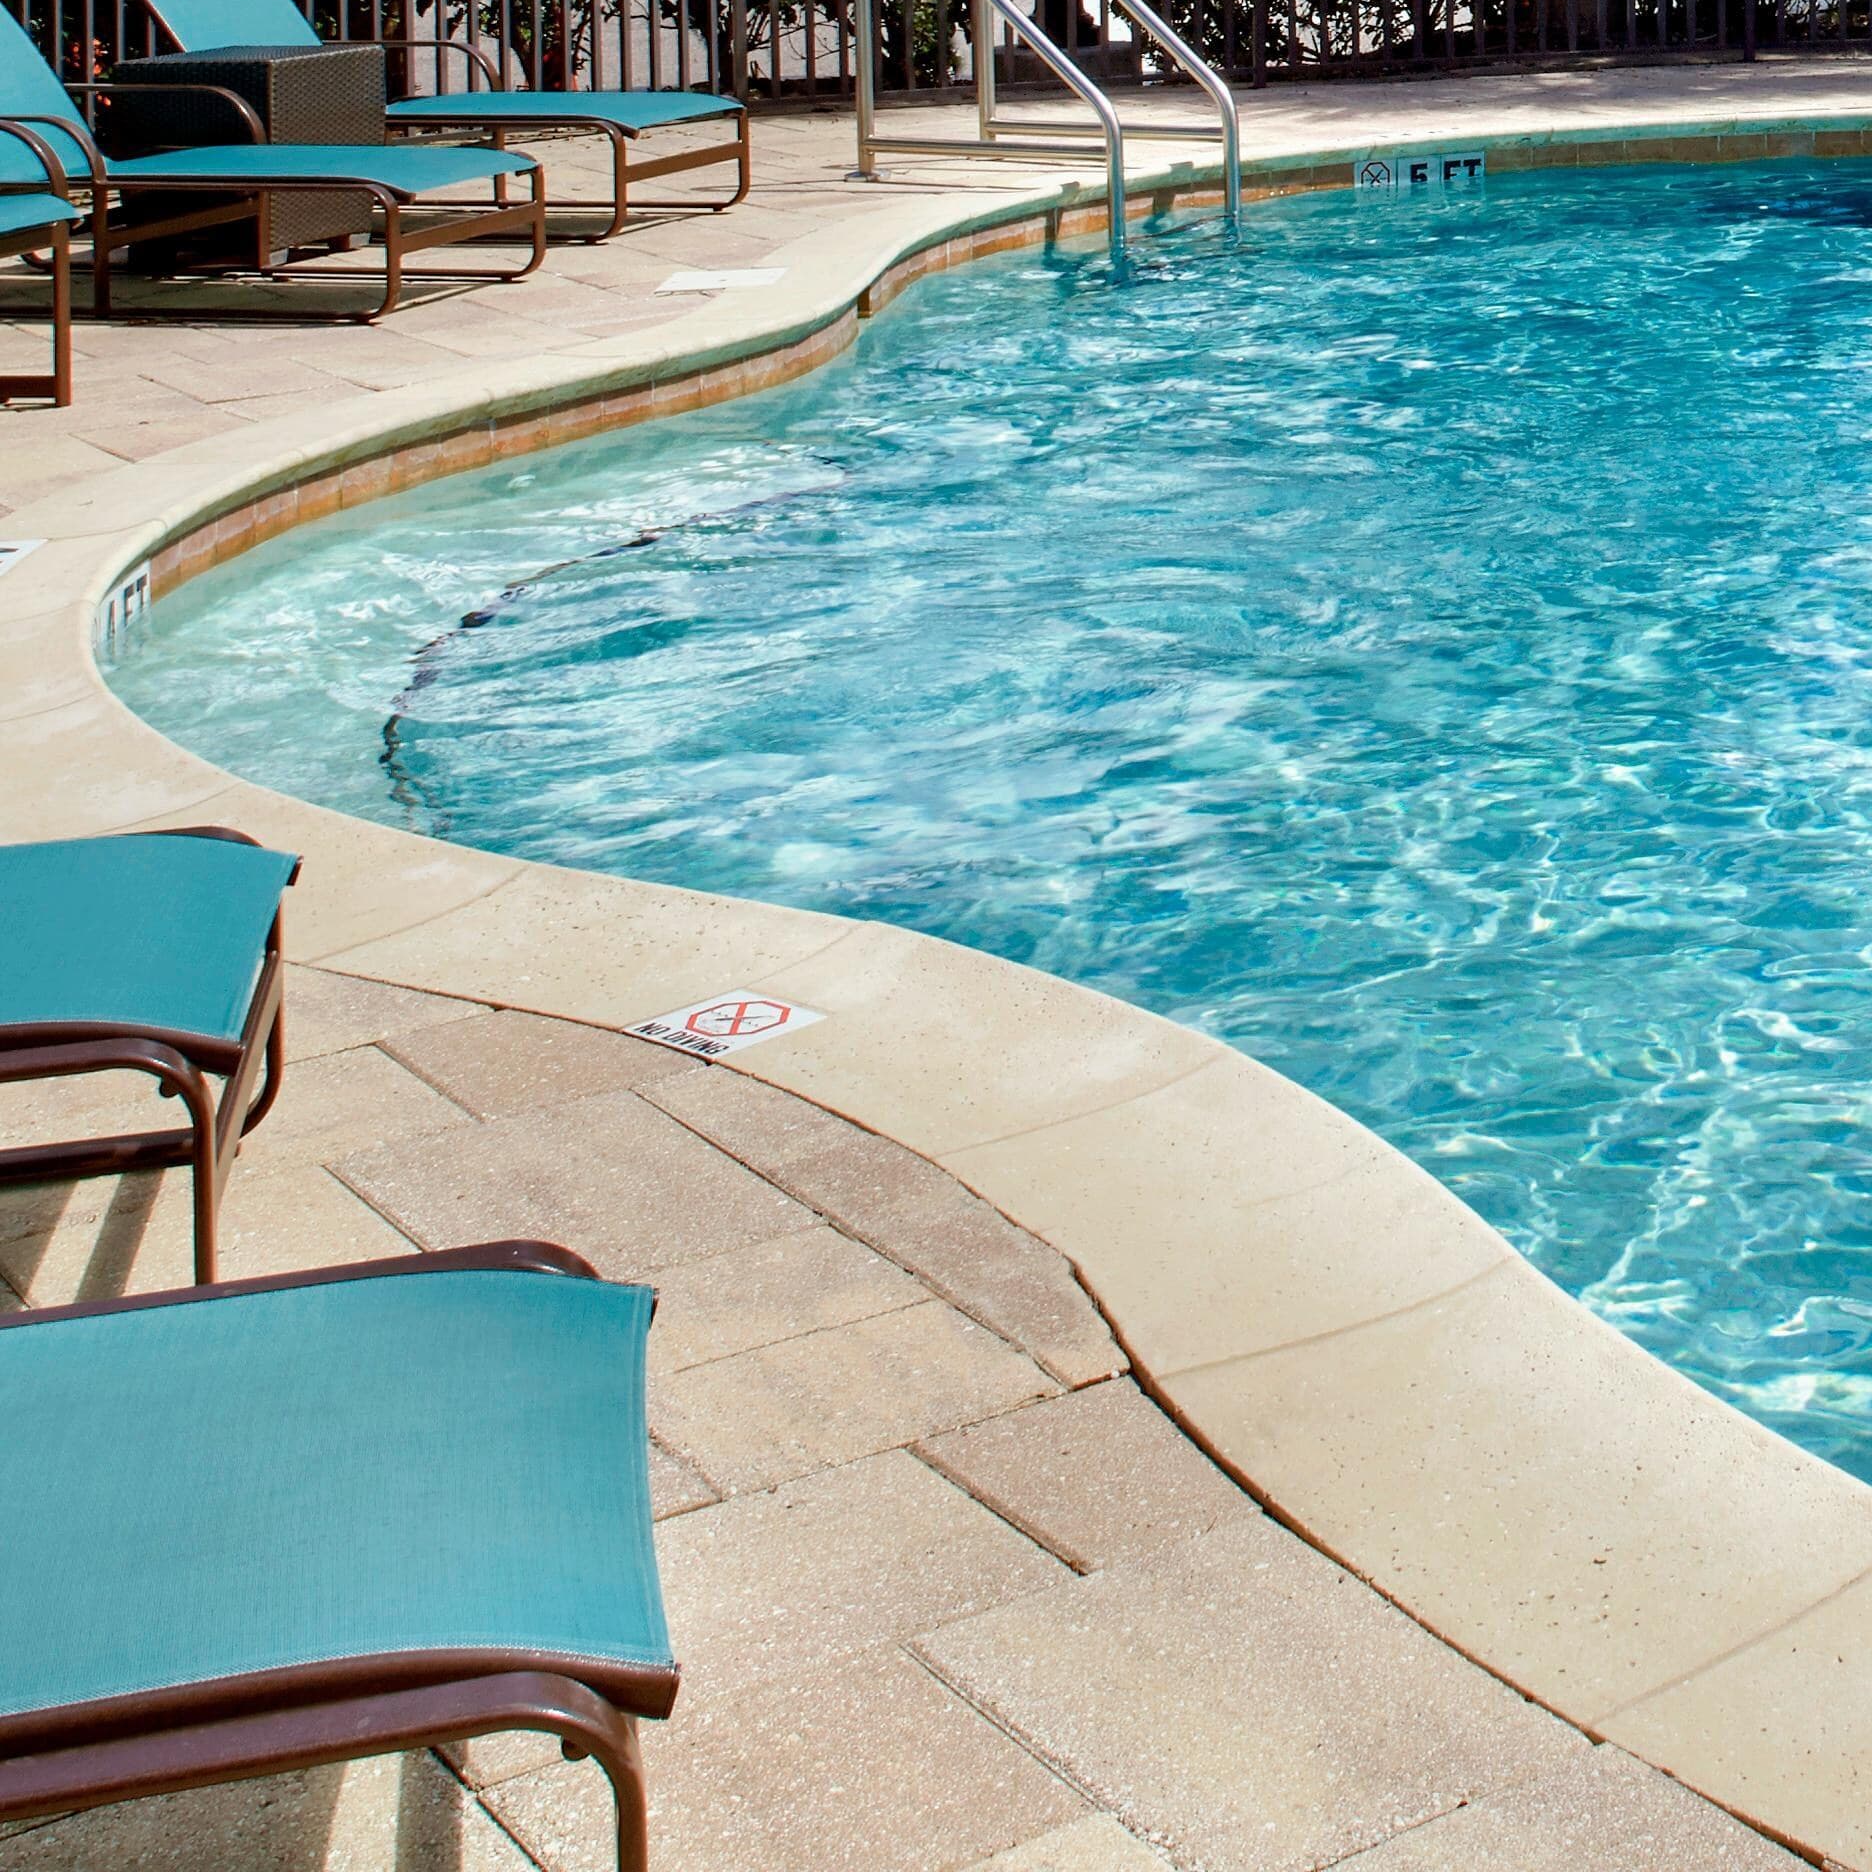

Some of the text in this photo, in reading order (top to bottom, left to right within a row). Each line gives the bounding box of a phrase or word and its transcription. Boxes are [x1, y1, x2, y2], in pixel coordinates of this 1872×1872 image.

[1444, 159, 1481, 180] FT
[634, 1022, 729, 1054] NO DIVING
